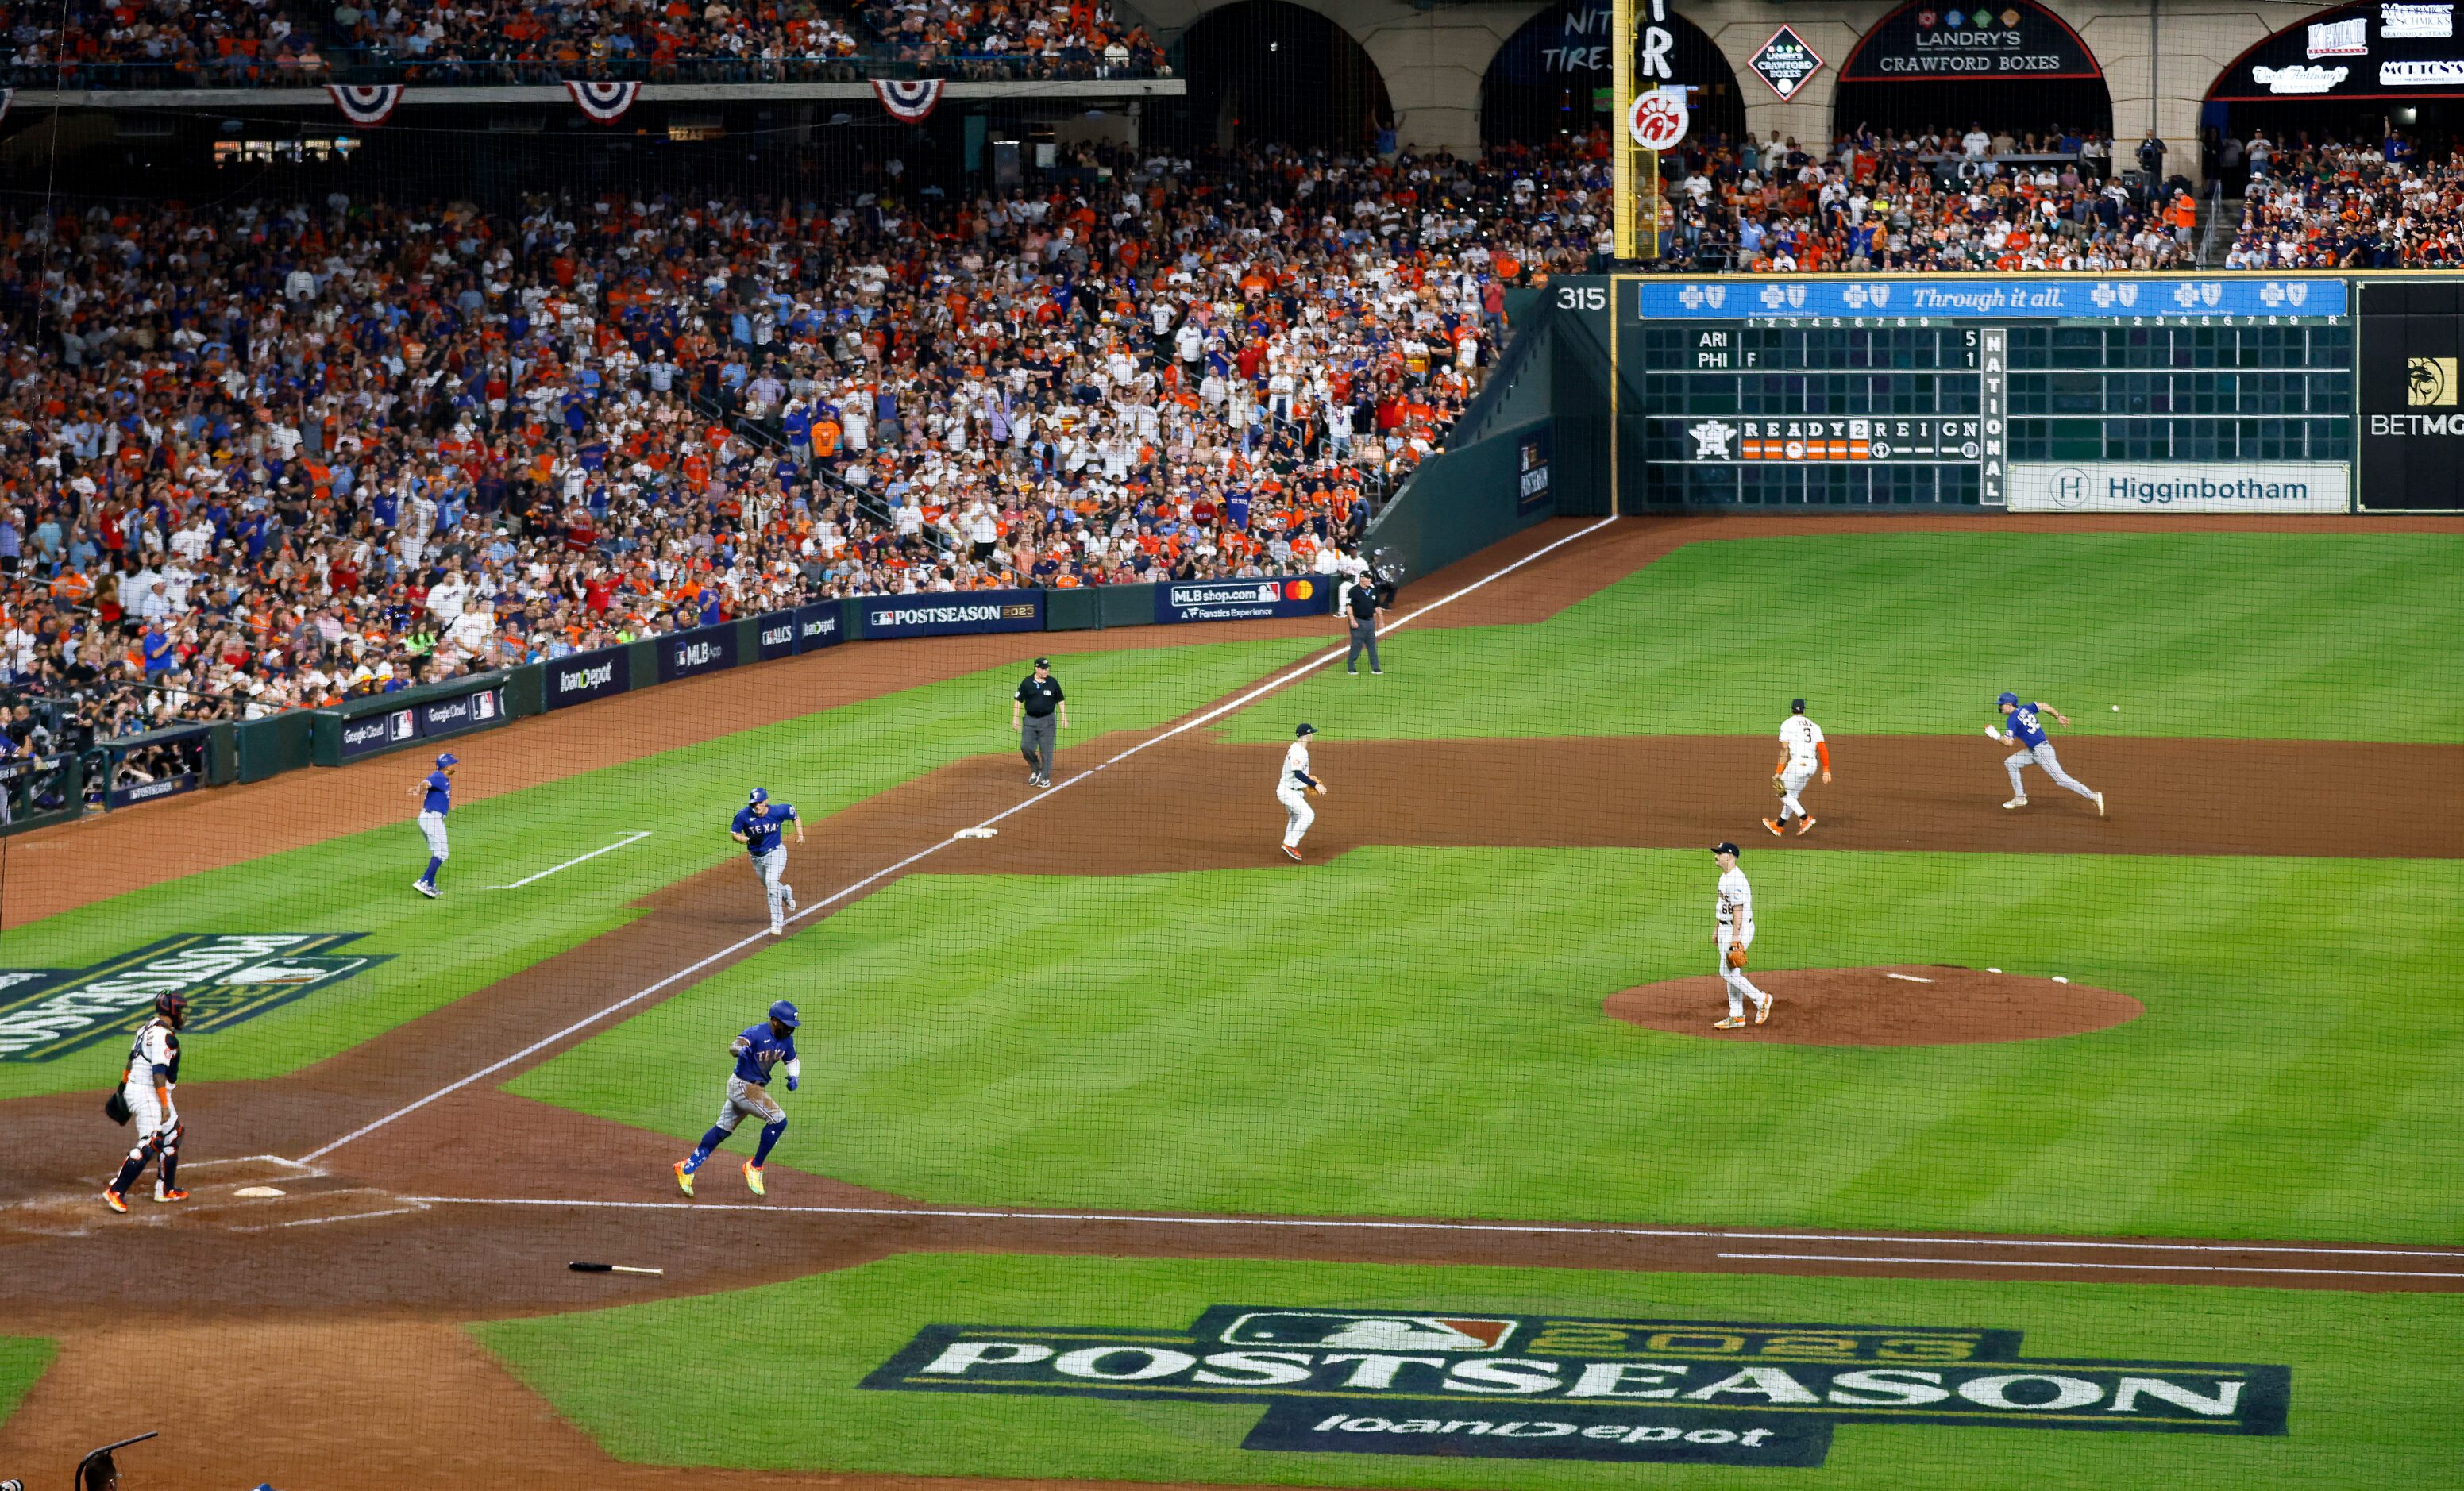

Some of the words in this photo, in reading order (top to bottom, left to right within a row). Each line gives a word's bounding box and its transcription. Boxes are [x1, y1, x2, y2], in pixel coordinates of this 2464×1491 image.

[1916, 32, 2022, 46] LANDRY'S
[1757, 60, 1814, 70] CRAWFORD
[1880, 56, 1991, 72] CRAWFORD
[1999, 56, 2061, 71] BOXES
[2384, 64, 2464, 75] MORTON'S
[1556, 287, 1606, 310] 315
[1913, 287, 2006, 312] Through
[2011, 287, 2027, 307] it
[2030, 288, 2065, 307] all.
[1699, 332, 1727, 347] ARI
[1965, 330, 1976, 347] 5
[1699, 353, 1728, 368] PHI
[1748, 353, 1756, 368] F
[1968, 352, 1974, 367] 1
[1985, 337, 2002, 496] NATIONAL
[1744, 422, 1845, 437] READY
[1874, 422, 1978, 437] REIGN
[2109, 477, 2308, 503] Higginbotham
[1174, 589, 1256, 603] MLBshop.com
[894, 605, 1001, 626] POSTSEASON
[1003, 607, 1035, 618] 2023
[1199, 609, 1230, 618] Fanatics
[1231, 607, 1273, 618] Experience
[773, 625, 792, 644] ALCS
[804, 617, 835, 636] loanDepot
[687, 641, 709, 667] MLB
[561, 661, 612, 692] loanDepot
[429, 706, 449, 723] Google
[449, 703, 467, 718] Cloud
[344, 729, 366, 745] Google
[366, 723, 384, 739] Cloud
[1803, 727, 1812, 743] 3
[1533, 1320, 1973, 1363] 2023
[920, 1342, 2246, 1416] POSTSEASON
[1313, 1413, 1776, 1448] loanDepot
